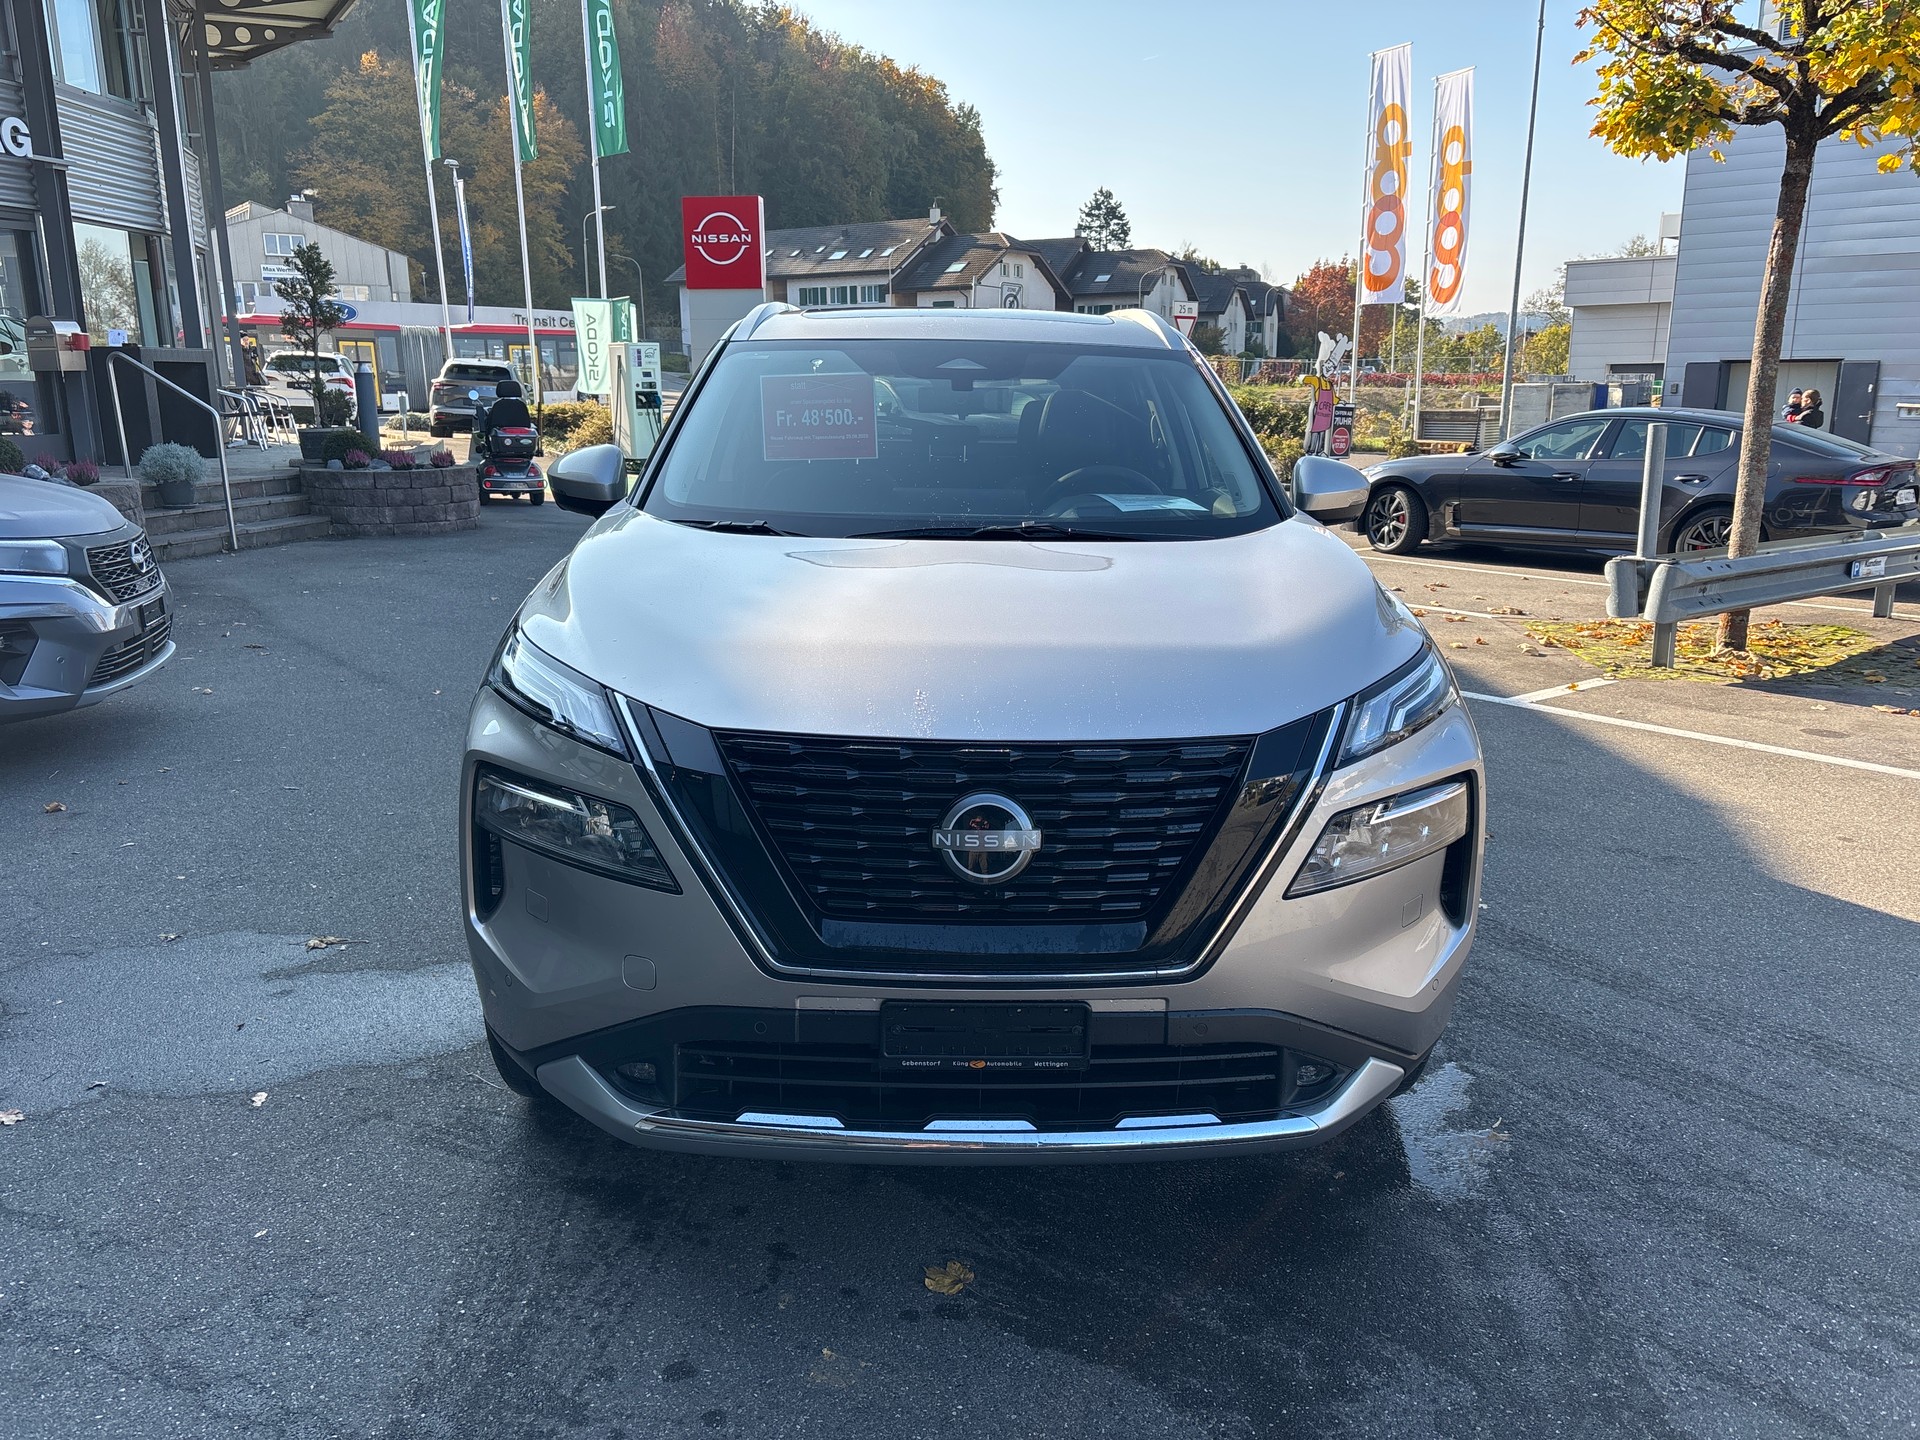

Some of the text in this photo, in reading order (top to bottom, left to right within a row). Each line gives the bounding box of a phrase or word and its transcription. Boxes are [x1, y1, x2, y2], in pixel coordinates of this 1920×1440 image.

[0, 116, 34, 159] G
[1364, 103, 1412, 292] coop
[1430, 125, 1472, 304] coop
[691, 233, 752, 244] NISSAN
[1179, 304, 1187, 314] 25
[514, 313, 556, 328] Trnsit
[775, 409, 797, 427] Fr.
[935, 832, 1018, 848] NISSAN
[1034, 1060, 1069, 1068] Wettingen
